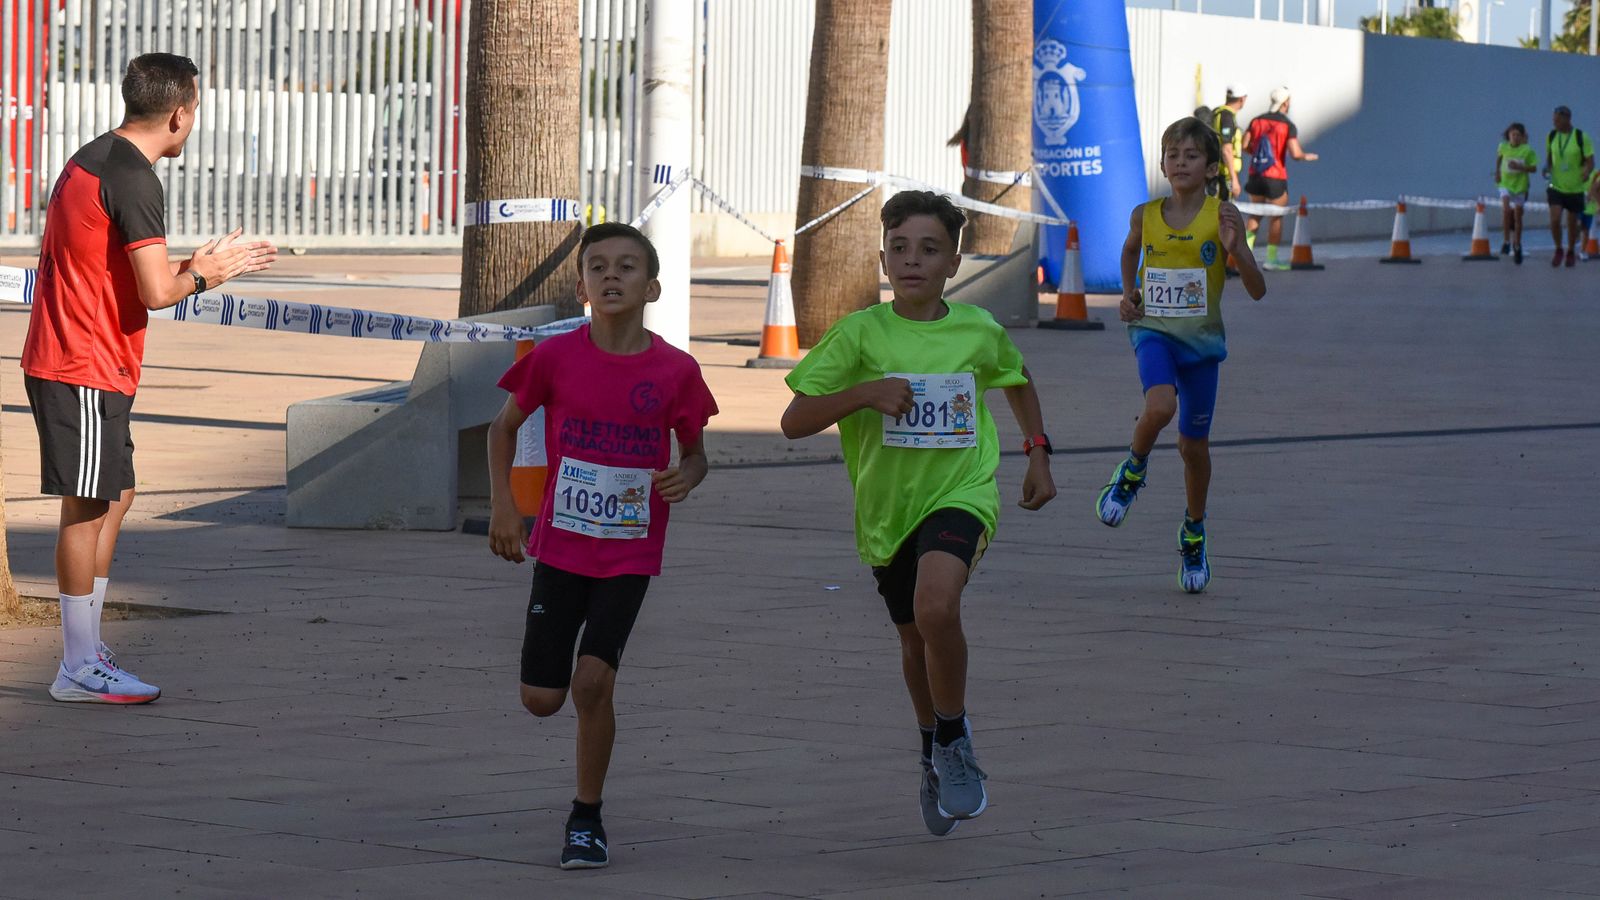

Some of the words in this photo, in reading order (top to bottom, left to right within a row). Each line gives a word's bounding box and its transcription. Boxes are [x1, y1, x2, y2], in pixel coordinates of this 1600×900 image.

[1035, 147, 1082, 159] EGACIÓN
[1084, 145, 1101, 157] DE
[1148, 285, 1184, 304] 1217
[895, 401, 948, 427] 081
[563, 418, 660, 442] ATLETISMO
[562, 464, 580, 478] XXI
[579, 474, 597, 482] Popular
[562, 486, 618, 519] 1030
